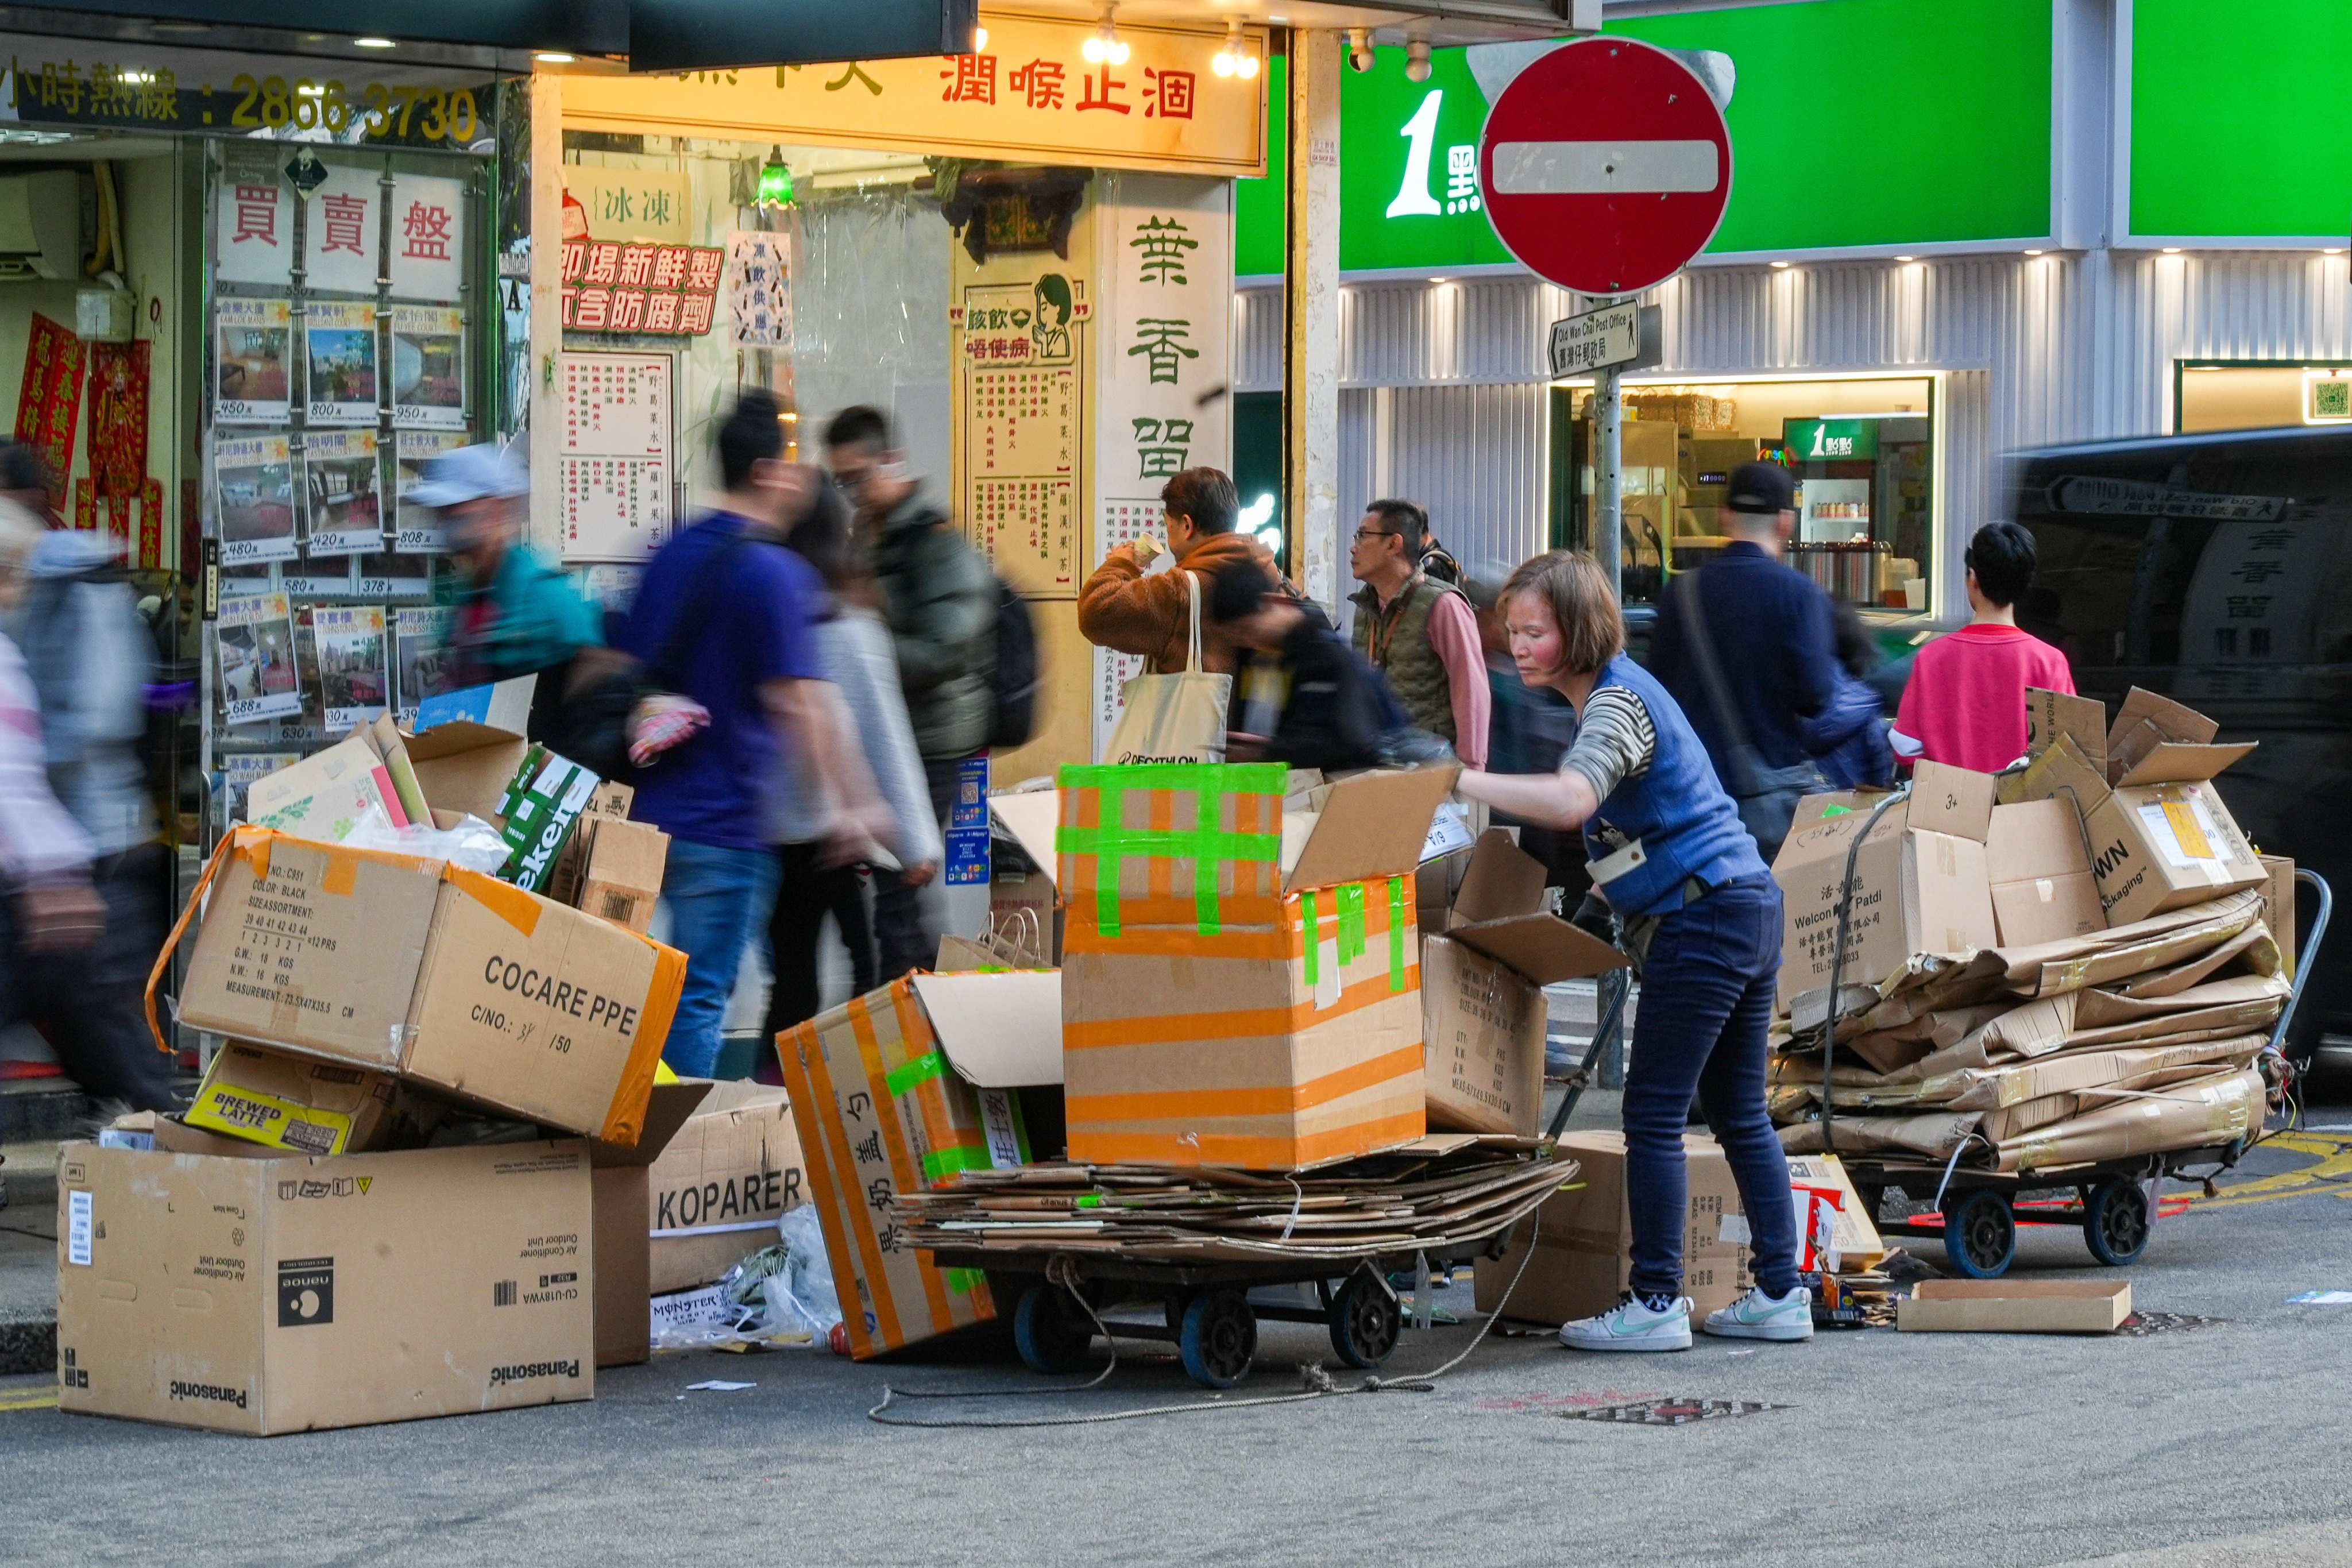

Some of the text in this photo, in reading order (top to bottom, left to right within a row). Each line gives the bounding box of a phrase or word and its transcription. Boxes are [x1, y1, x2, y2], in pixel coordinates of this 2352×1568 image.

[231, 72, 348, 132] 2866
[365, 82, 476, 142] 3730
[606, 187, 671, 226] 冰凍
[233, 185, 451, 261] 買 賣 盤
[1559, 315, 1627, 342] Old Wan Chai Post Office
[221, 401, 244, 414] 450
[311, 403, 334, 415] 800
[397, 407, 419, 419] 950
[230, 542, 252, 555] 480
[314, 533, 336, 546] 420
[363, 580, 385, 592] 378
[233, 701, 254, 713] 688
[287, 867, 304, 882] C951
[281, 885, 306, 901] BLACK
[1795, 889, 1882, 930] Welcon Patdi
[245, 913, 308, 936] 39 40 41 42 43 44
[1799, 912, 1880, 949] 活奇能貿有限公司
[253, 932, 258, 944] 2
[263, 935, 268, 947] 3
[276, 937, 281, 949] 3
[285, 939, 292, 951] 2
[1809, 933, 1864, 960] 專營清用品
[260, 952, 269, 964] 18
[278, 955, 294, 970] KGS
[257, 968, 265, 980] 16
[273, 972, 289, 987] KGS
[485, 955, 638, 1037] COCARE PPE
[342, 1006, 354, 1019] CM
[472, 1005, 571, 1054] C/NO.: /50
[214, 1092, 282, 1121] BREWED
[218, 1104, 267, 1128] LATTE
[657, 1167, 801, 1230] KOPARER
[527, 1234, 578, 1248] Outdoor Unit
[199, 1254, 245, 1269] Outdoor Unit
[520, 1246, 578, 1259] Air Conditioner
[193, 1266, 245, 1282] Air Conditioner
[283, 1275, 329, 1287] nanoe
[522, 1288, 578, 1304] CU-U18YWA
[491, 1359, 580, 1385] Panasonic
[168, 1380, 247, 1409] Panasonic
